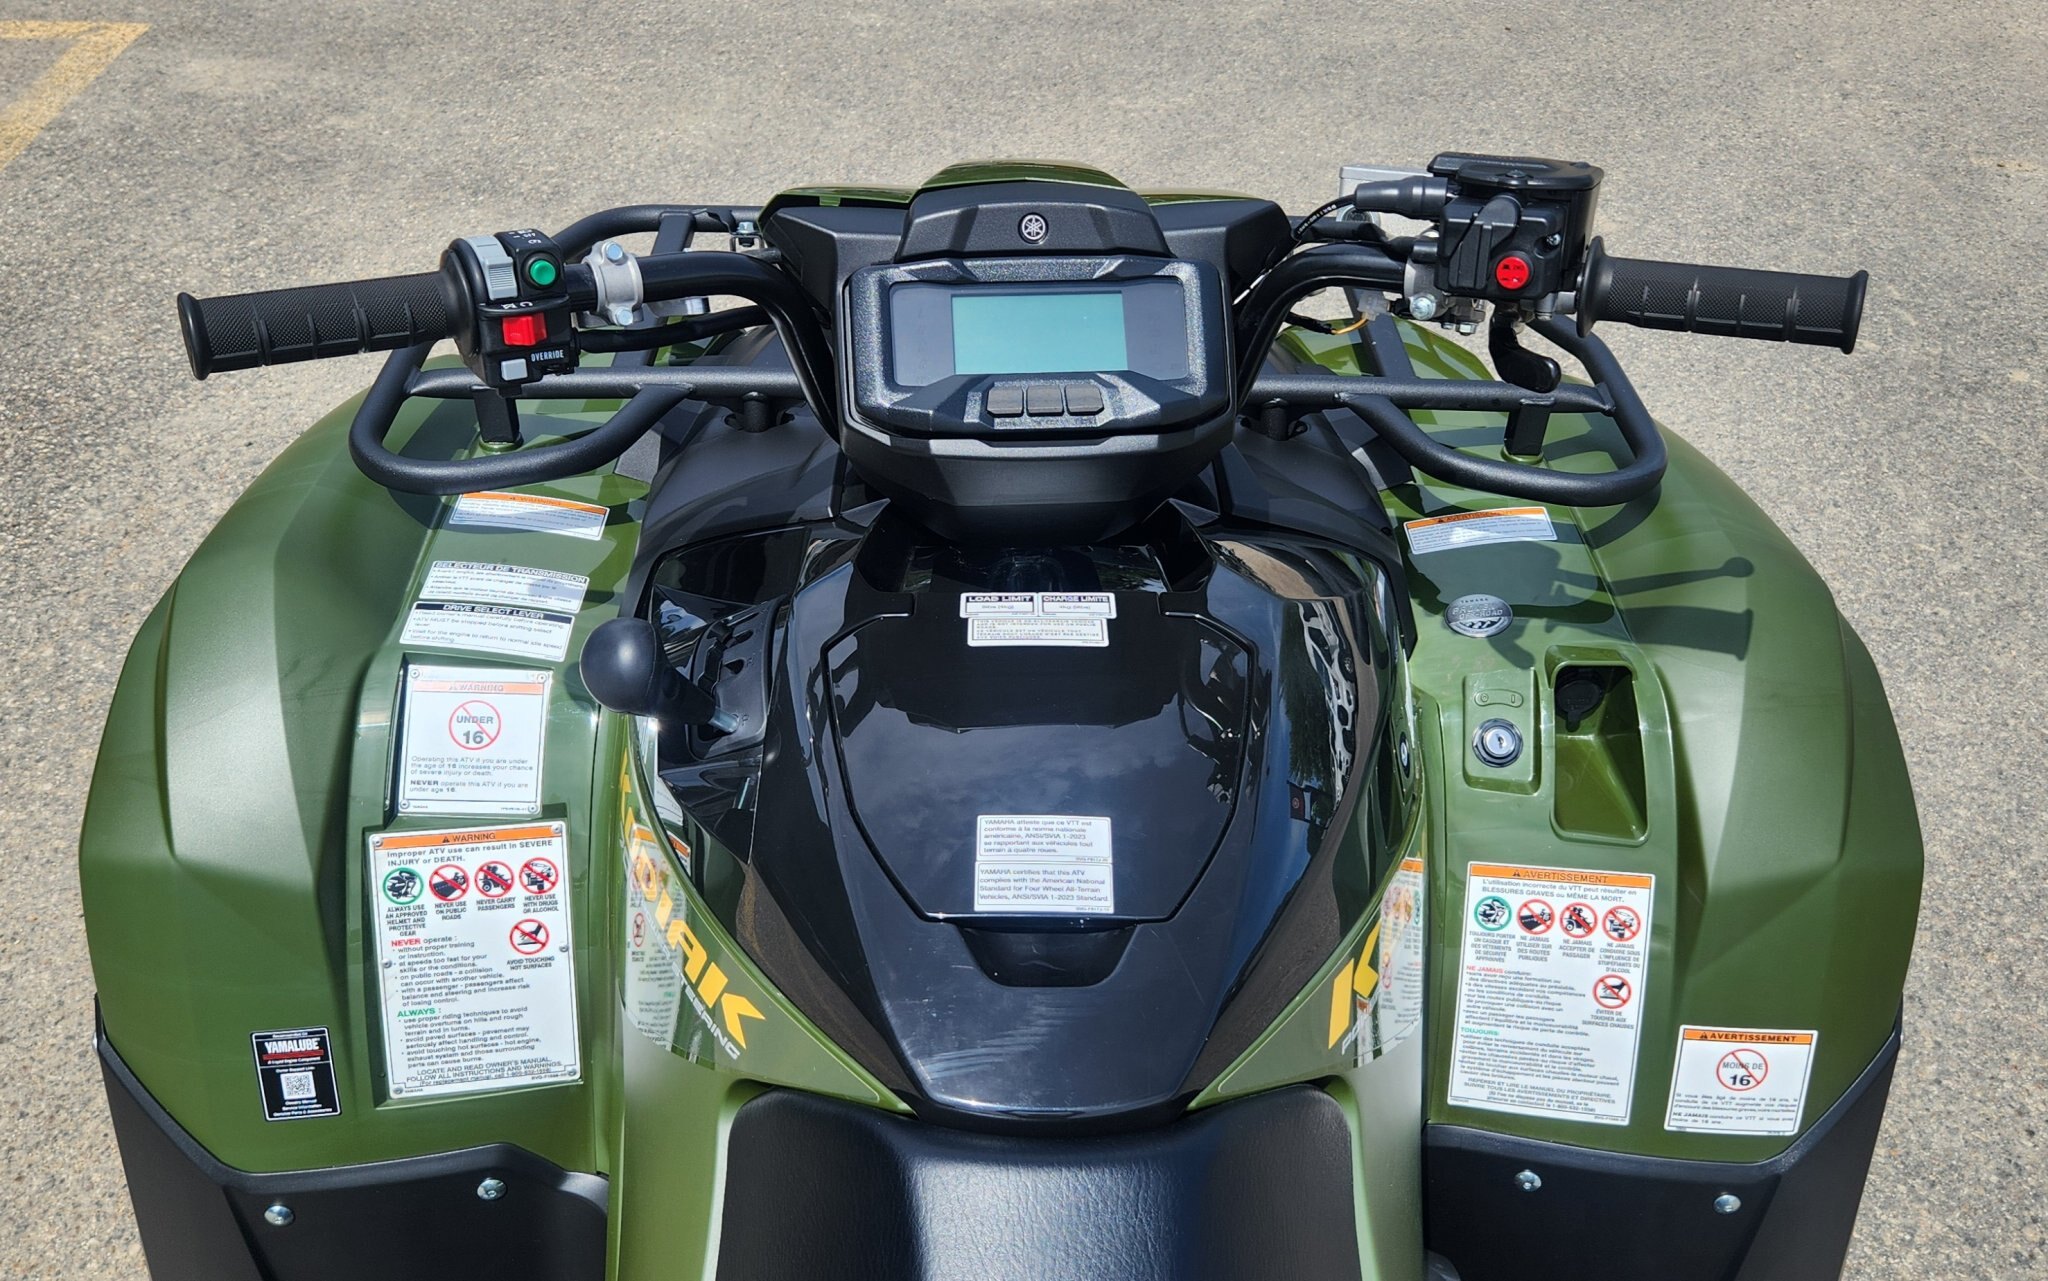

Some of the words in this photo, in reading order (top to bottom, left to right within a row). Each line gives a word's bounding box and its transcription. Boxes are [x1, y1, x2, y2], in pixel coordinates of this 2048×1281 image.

[530, 350, 564, 362] OVERRIDE
[436, 562, 496, 572] SELECTEUR
[512, 566, 586, 583] TRANSMISSION
[474, 606, 510, 616] SELECT
[512, 610, 544, 619] LEVER
[460, 683, 504, 692] WARNING
[456, 715, 494, 724] UNDER
[462, 730, 485, 744] 16
[453, 832, 496, 842] WARNING
[387, 849, 427, 859] Improper
[482, 843, 507, 851] result
[518, 840, 553, 848] SEVERE
[387, 858, 420, 867] INJURY
[1522, 870, 1609, 884] AVERTISSEMENT
[477, 903, 515, 911] PASSENGERS
[395, 910, 428, 918] APPROVED
[388, 923, 426, 931] PROTECTIVE
[391, 938, 421, 946] NEVER
[423, 935, 453, 945] operate
[448, 941, 475, 950] training
[410, 999, 432, 1007] losing
[397, 1007, 436, 1017] ALWAYS
[1710, 1032, 1797, 1042] AVERTISSEMENT
[264, 1038, 320, 1054] YAMALUBE
[407, 1061, 426, 1070] parts
[416, 1067, 446, 1076] LOCATE
[485, 1060, 519, 1069] OWNER'S
[406, 1074, 437, 1082] FOLLOW
[452, 1067, 506, 1078] INSTRUCTIONS
[1728, 1074, 1752, 1086] 16
